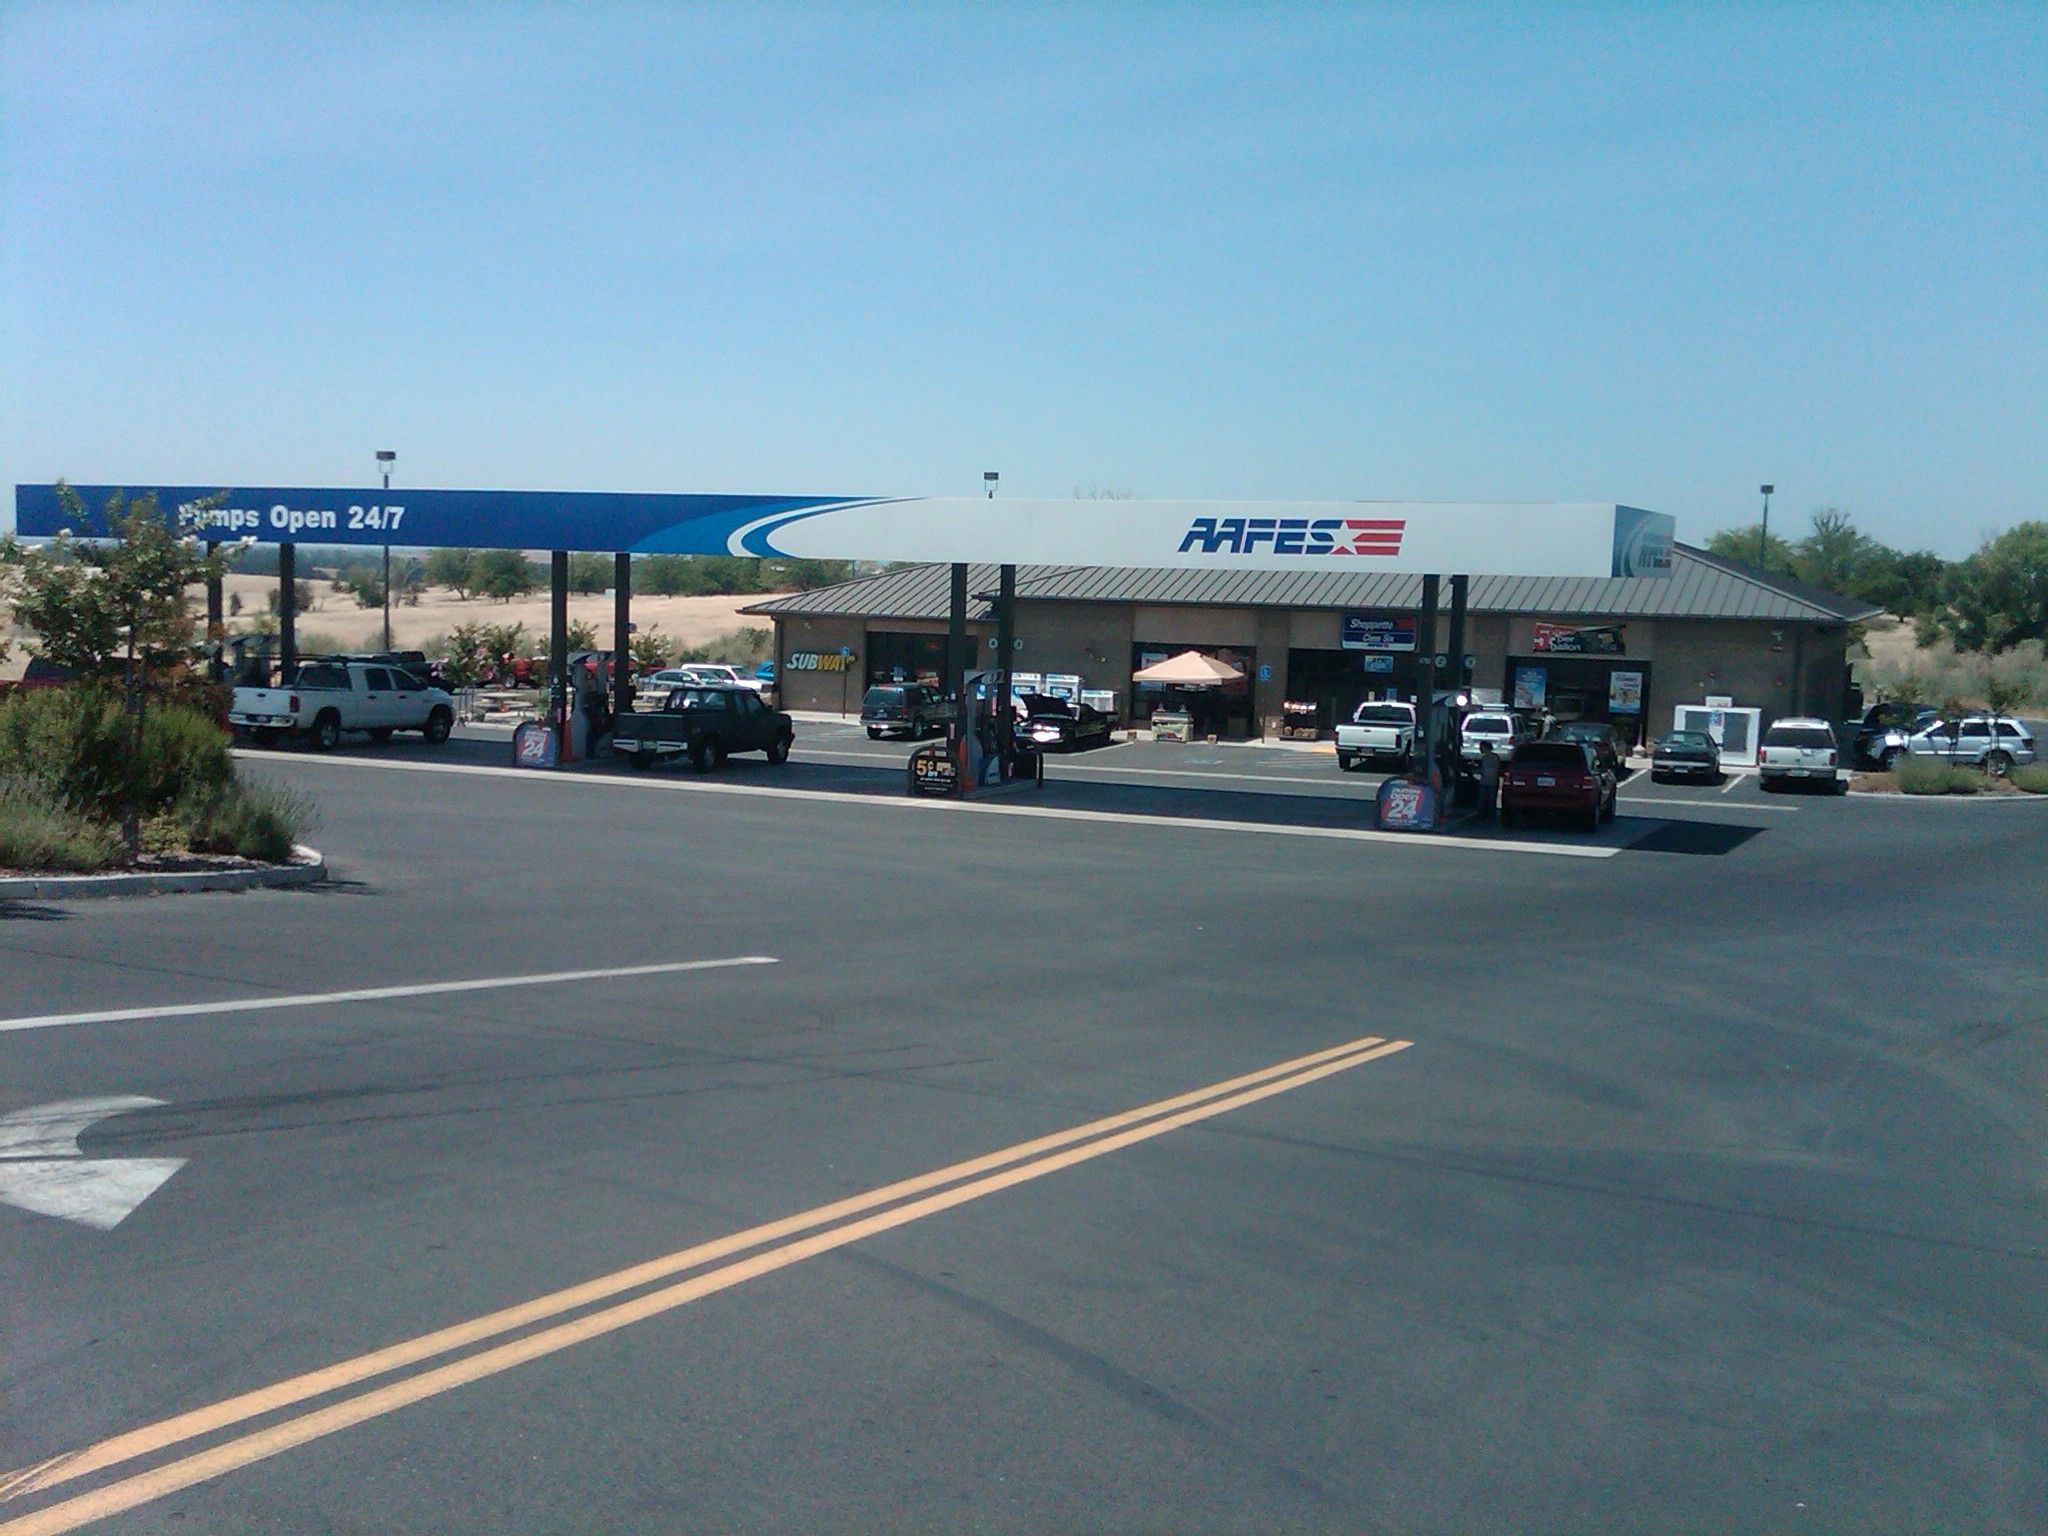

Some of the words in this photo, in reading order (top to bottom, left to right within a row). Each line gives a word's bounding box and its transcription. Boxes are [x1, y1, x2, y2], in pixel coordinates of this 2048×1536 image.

[269, 504, 336, 533] Open
[347, 506, 405, 530] 24/7
[1177, 518, 1344, 555] AAFES
[1349, 617, 1394, 631] Shoppette
[786, 653, 856, 672] SUBWAY
[1387, 800, 1417, 819] 24
